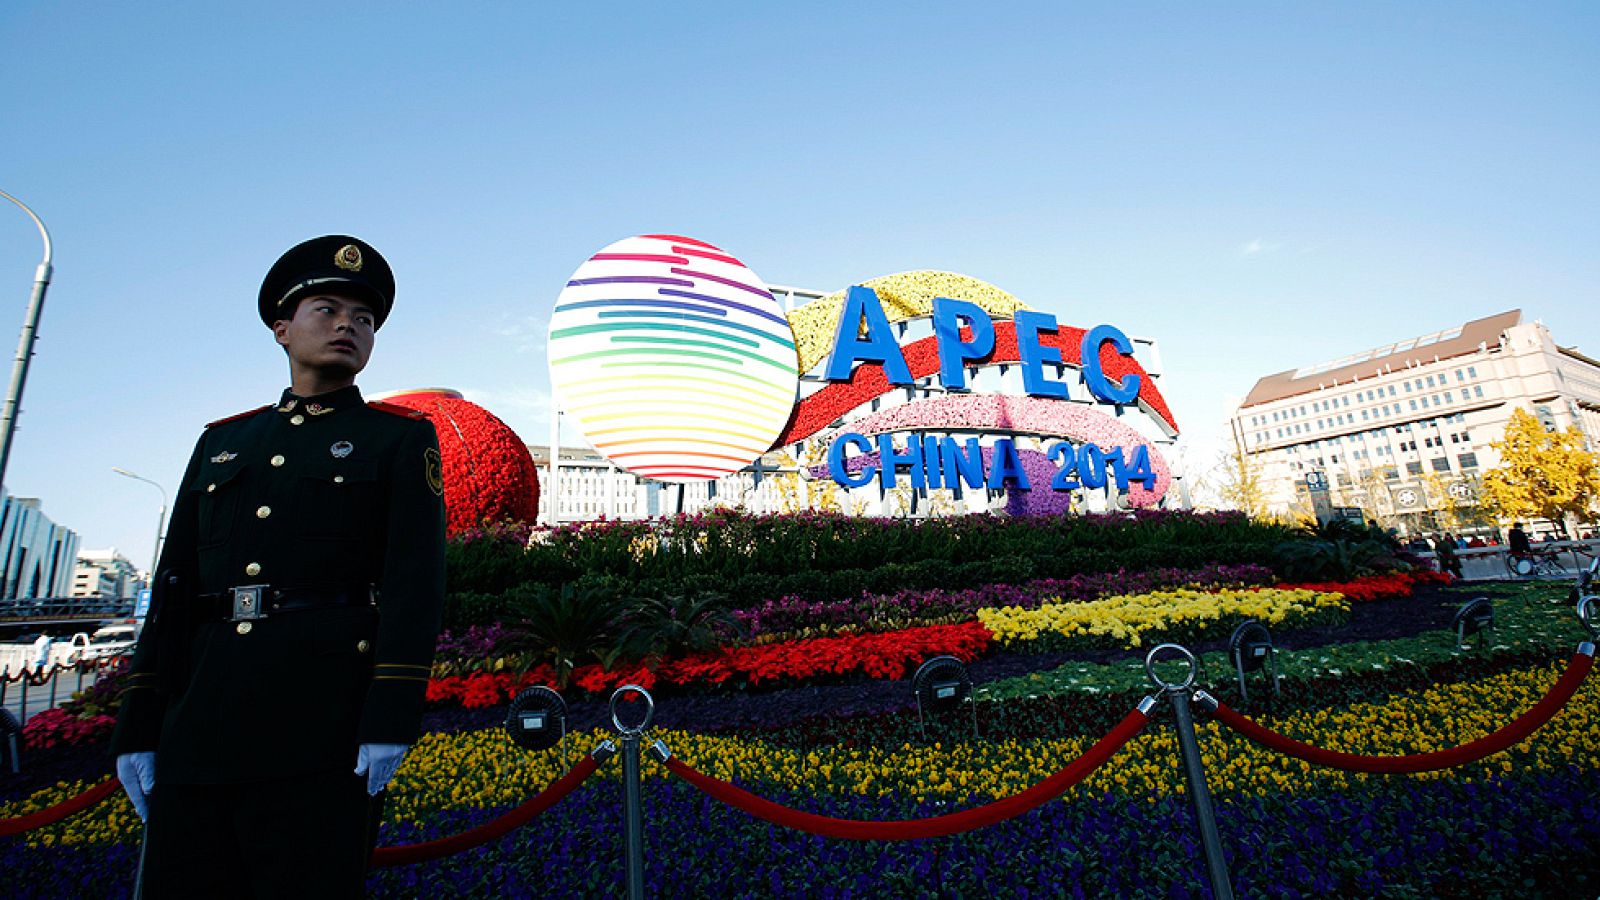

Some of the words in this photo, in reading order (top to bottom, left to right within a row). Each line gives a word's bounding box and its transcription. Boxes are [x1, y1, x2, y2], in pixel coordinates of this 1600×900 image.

[825, 285, 1141, 404] APEC
[828, 432, 1032, 491] CHINA
[1047, 441, 1157, 491] 2014
